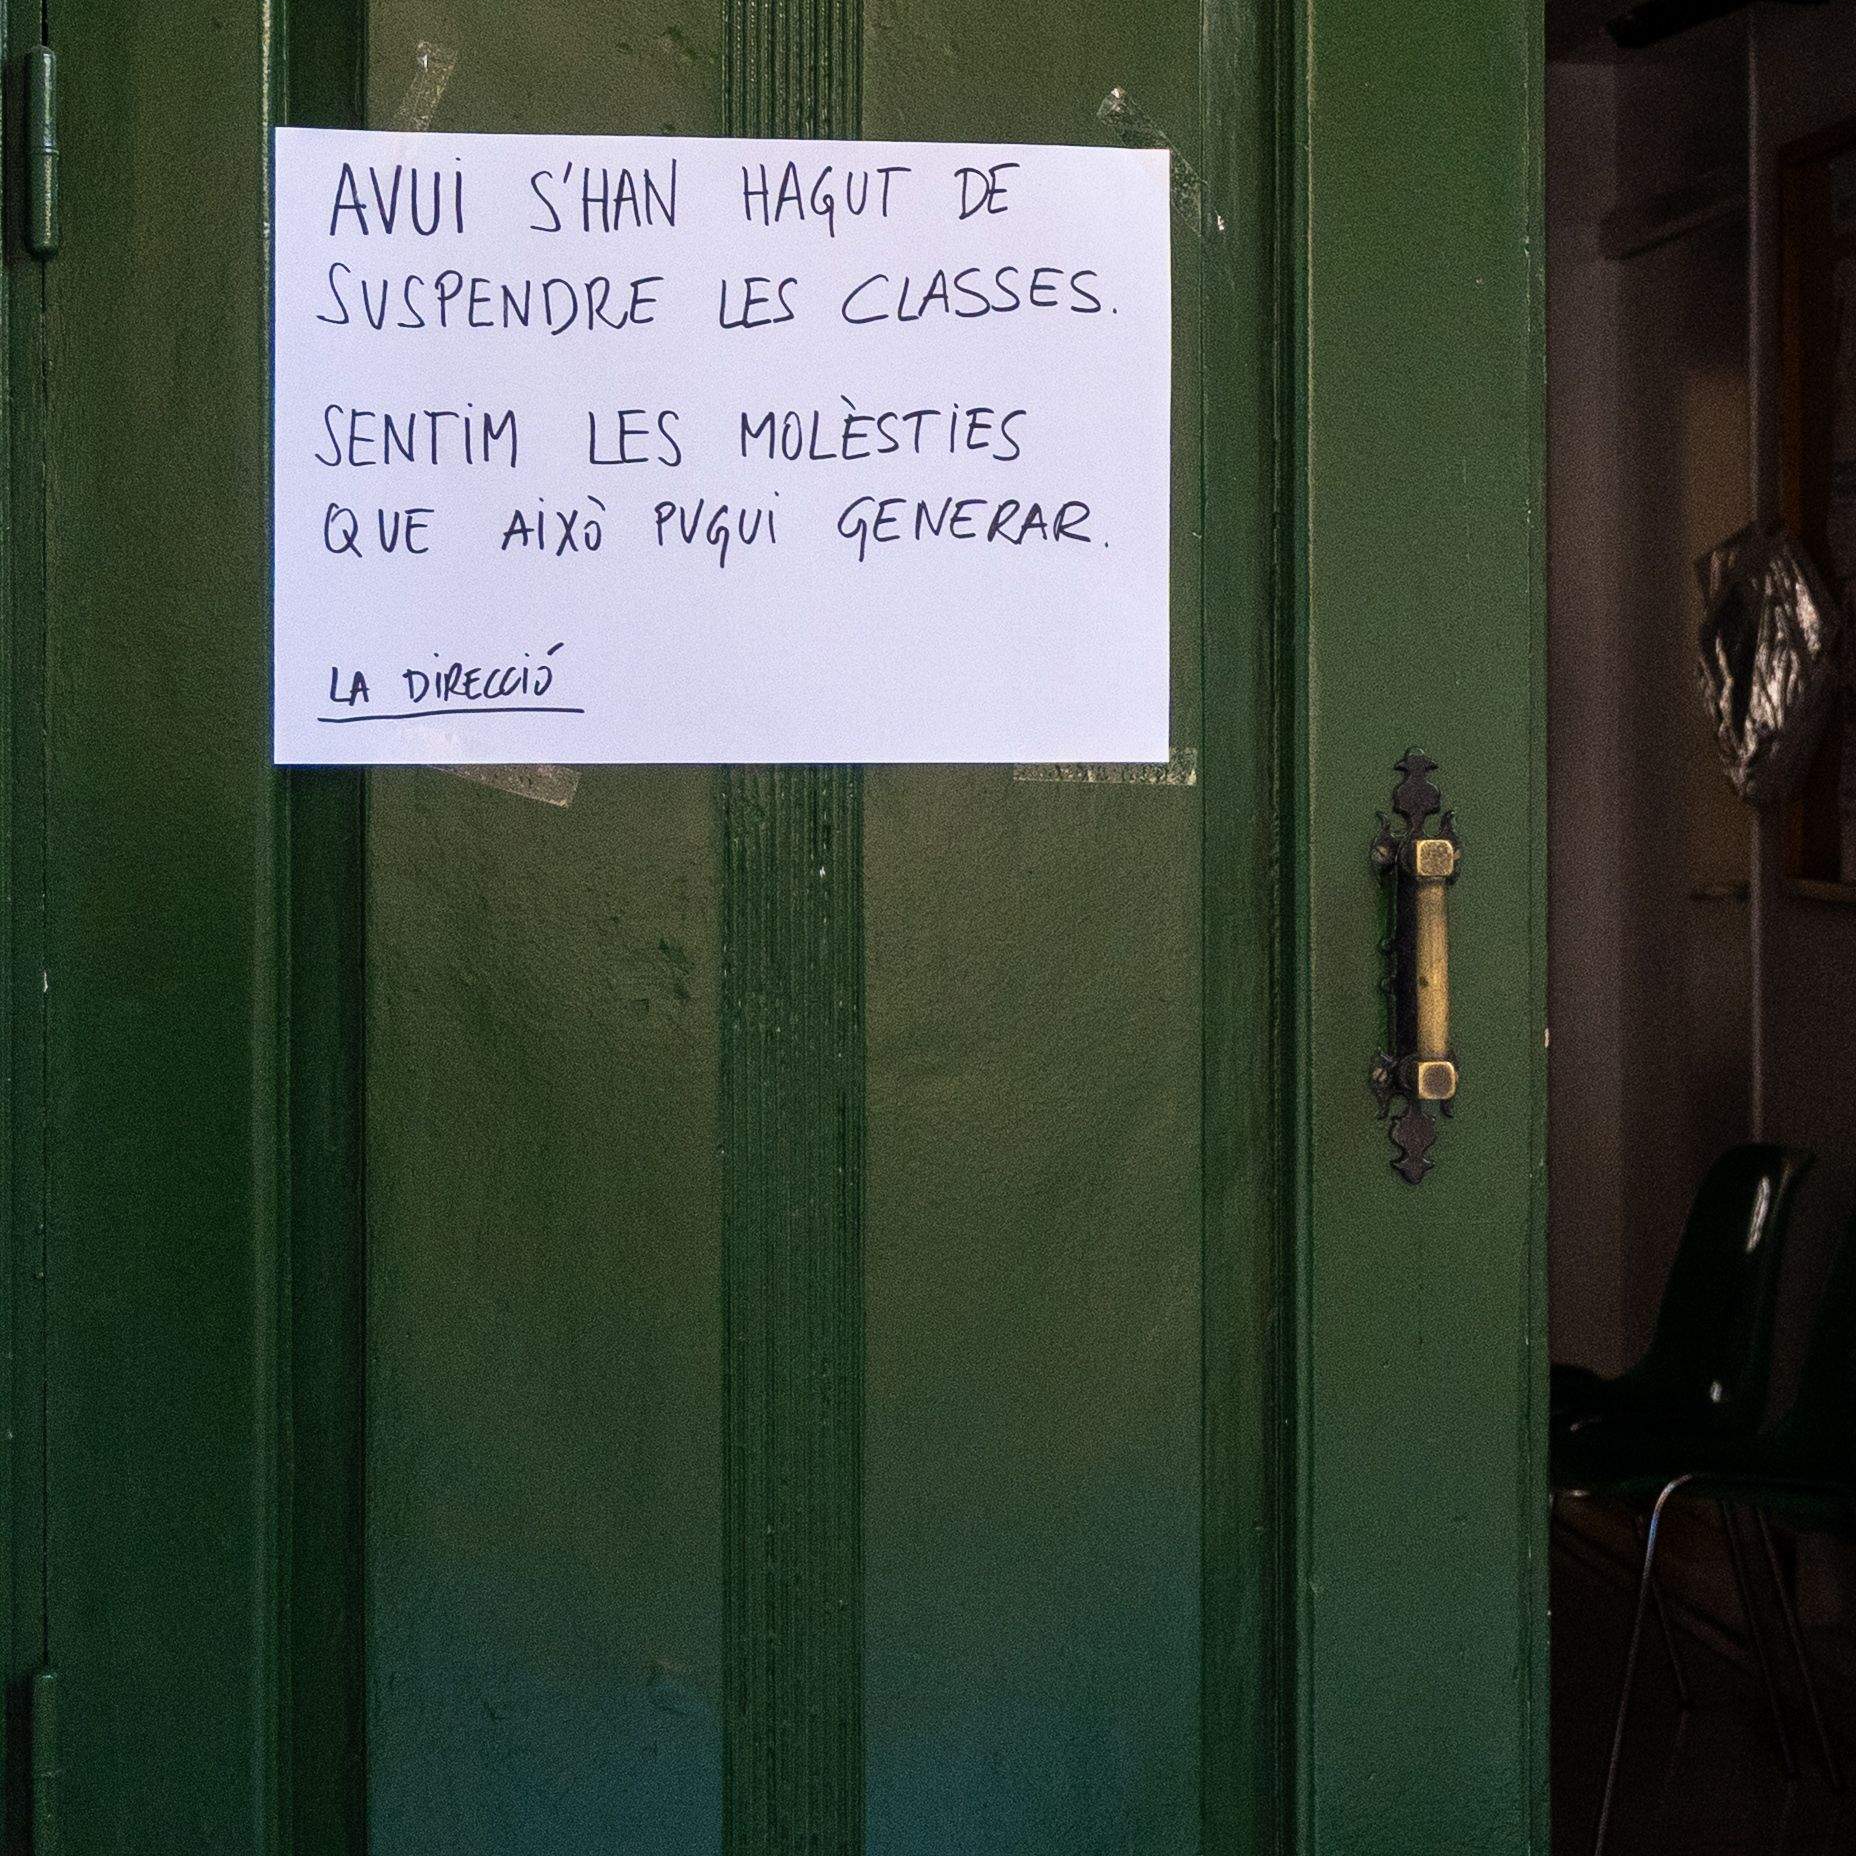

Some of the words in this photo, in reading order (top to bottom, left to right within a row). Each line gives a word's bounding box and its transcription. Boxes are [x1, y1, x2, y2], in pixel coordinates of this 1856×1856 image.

[530, 158, 677, 233] S'HAN
[742, 161, 911, 238] HAGUT
[954, 162, 1020, 220] DE
[316, 262, 664, 336] SUSPENDRE
[719, 276, 798, 330] LES
[841, 266, 1118, 325] CLASSES.
[588, 409, 682, 467] LES
[323, 502, 435, 558] QUE
[837, 495, 1110, 563] GENERAR.
[329, 666, 369, 707] LA
